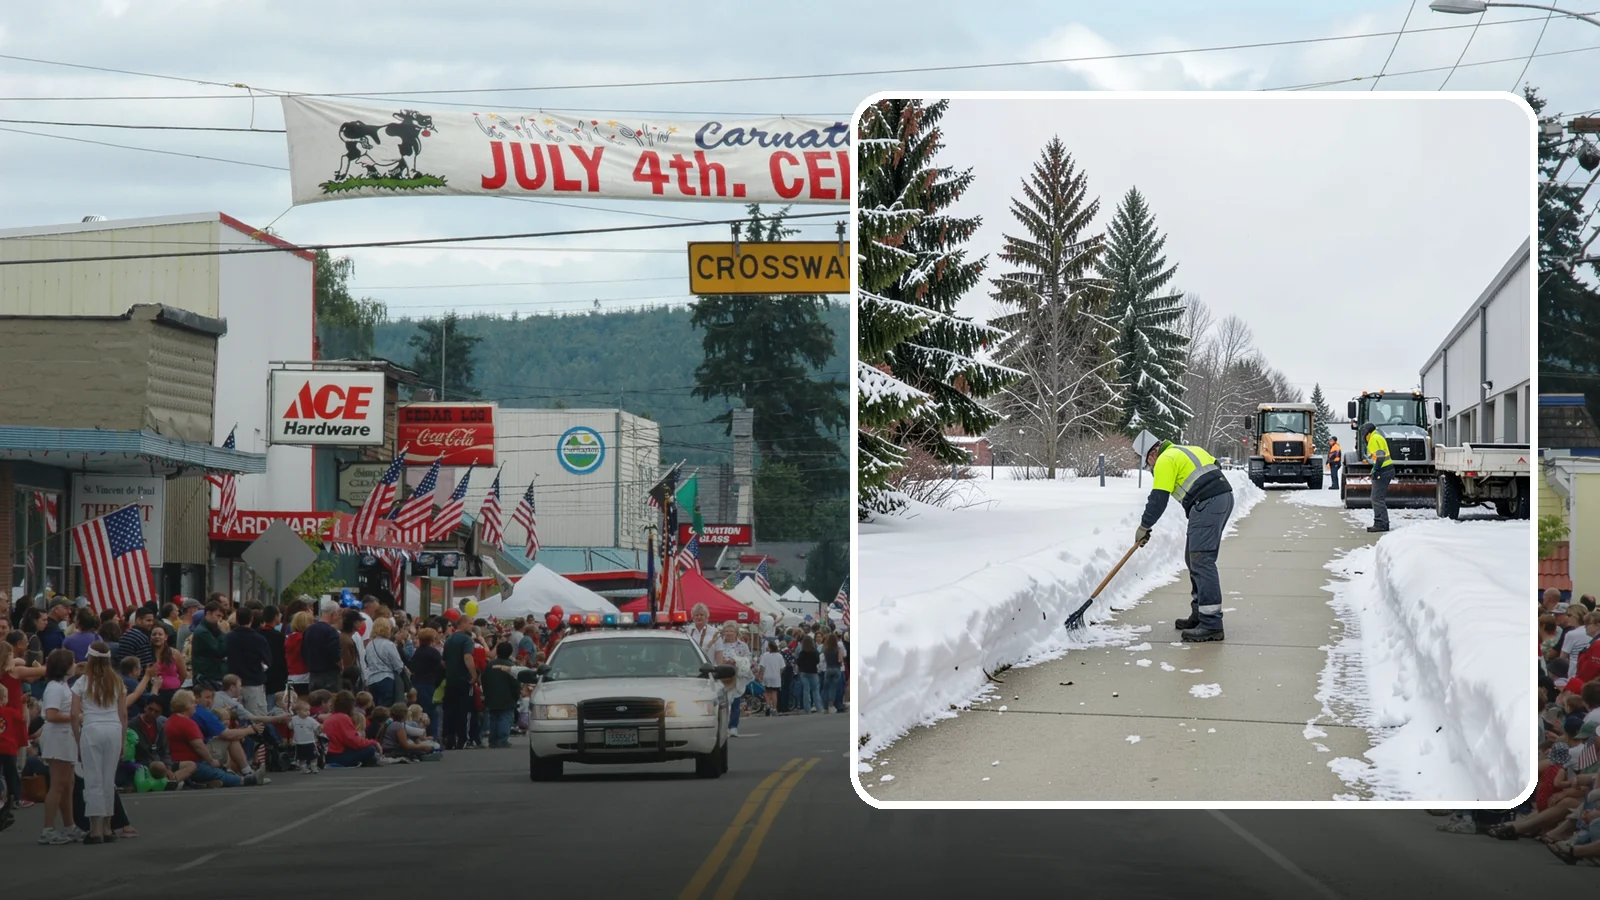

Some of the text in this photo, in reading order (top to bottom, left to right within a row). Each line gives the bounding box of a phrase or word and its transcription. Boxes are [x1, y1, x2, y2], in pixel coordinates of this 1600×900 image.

[481, 141, 604, 192] JULY
[632, 150, 746, 198] 4th.
[697, 254, 850, 280] CROSSWA
[282, 380, 374, 420] ACE
[406, 409, 485, 422] CEDAR LOG
[283, 421, 371, 437] Hardware
[416, 428, 477, 447] Coca-Cola
[353, 467, 385, 480] Simpl
[96, 485, 124, 495] Vincent
[126, 486, 136, 495] de
[138, 486, 155, 495] Paul
[688, 526, 742, 535] CRNATION
[699, 535, 730, 544] GLASS
